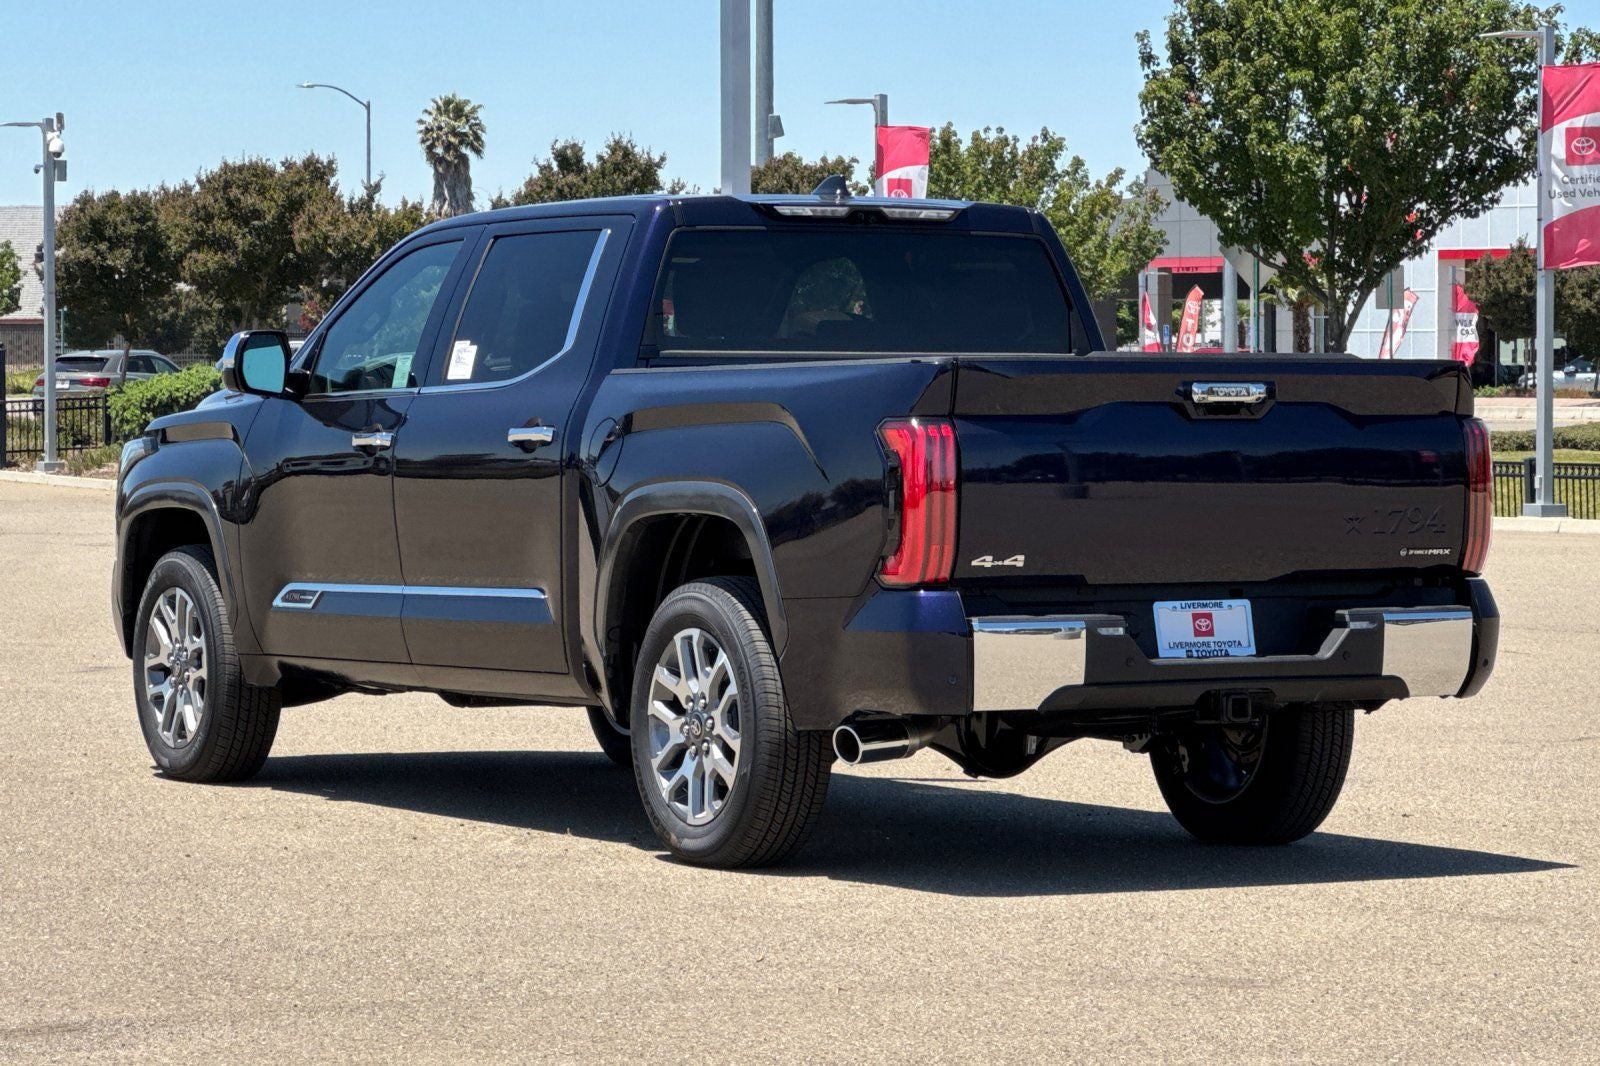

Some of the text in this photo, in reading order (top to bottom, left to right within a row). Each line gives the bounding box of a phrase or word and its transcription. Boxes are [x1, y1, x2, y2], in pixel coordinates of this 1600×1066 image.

[1548, 188, 1577, 200] Used
[1212, 387, 1249, 397] TOYOTA
[1372, 505, 1446, 534] 1794
[1180, 601, 1224, 610] LIVERMORE
[1168, 640, 1243, 649] LIVERMORE TOYOTA
[1195, 649, 1230, 658] TOYOTA
